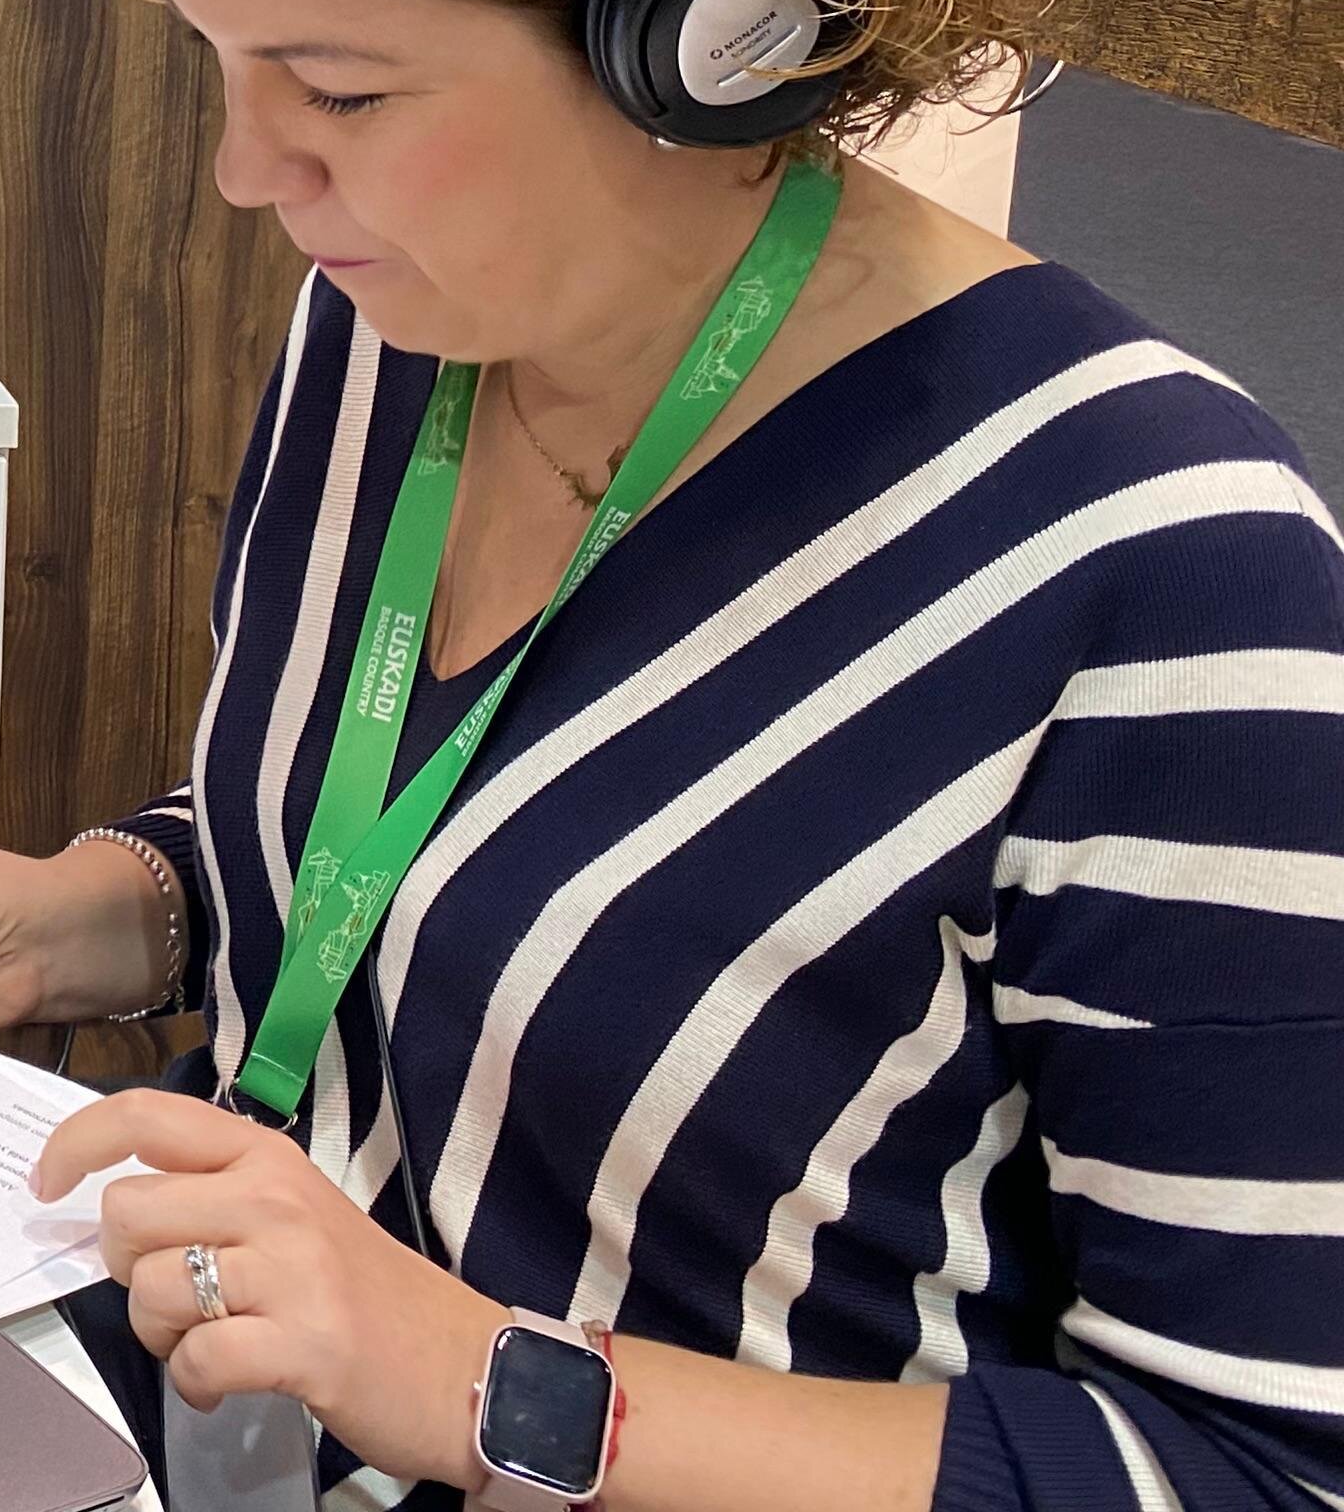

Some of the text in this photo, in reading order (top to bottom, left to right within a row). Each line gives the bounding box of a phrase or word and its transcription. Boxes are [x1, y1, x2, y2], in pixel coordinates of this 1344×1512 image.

[723, 9, 779, 53] MONACOR
[355, 605, 393, 718] BASQUE COUNTRY
[371, 611, 417, 724] EUSKADI
